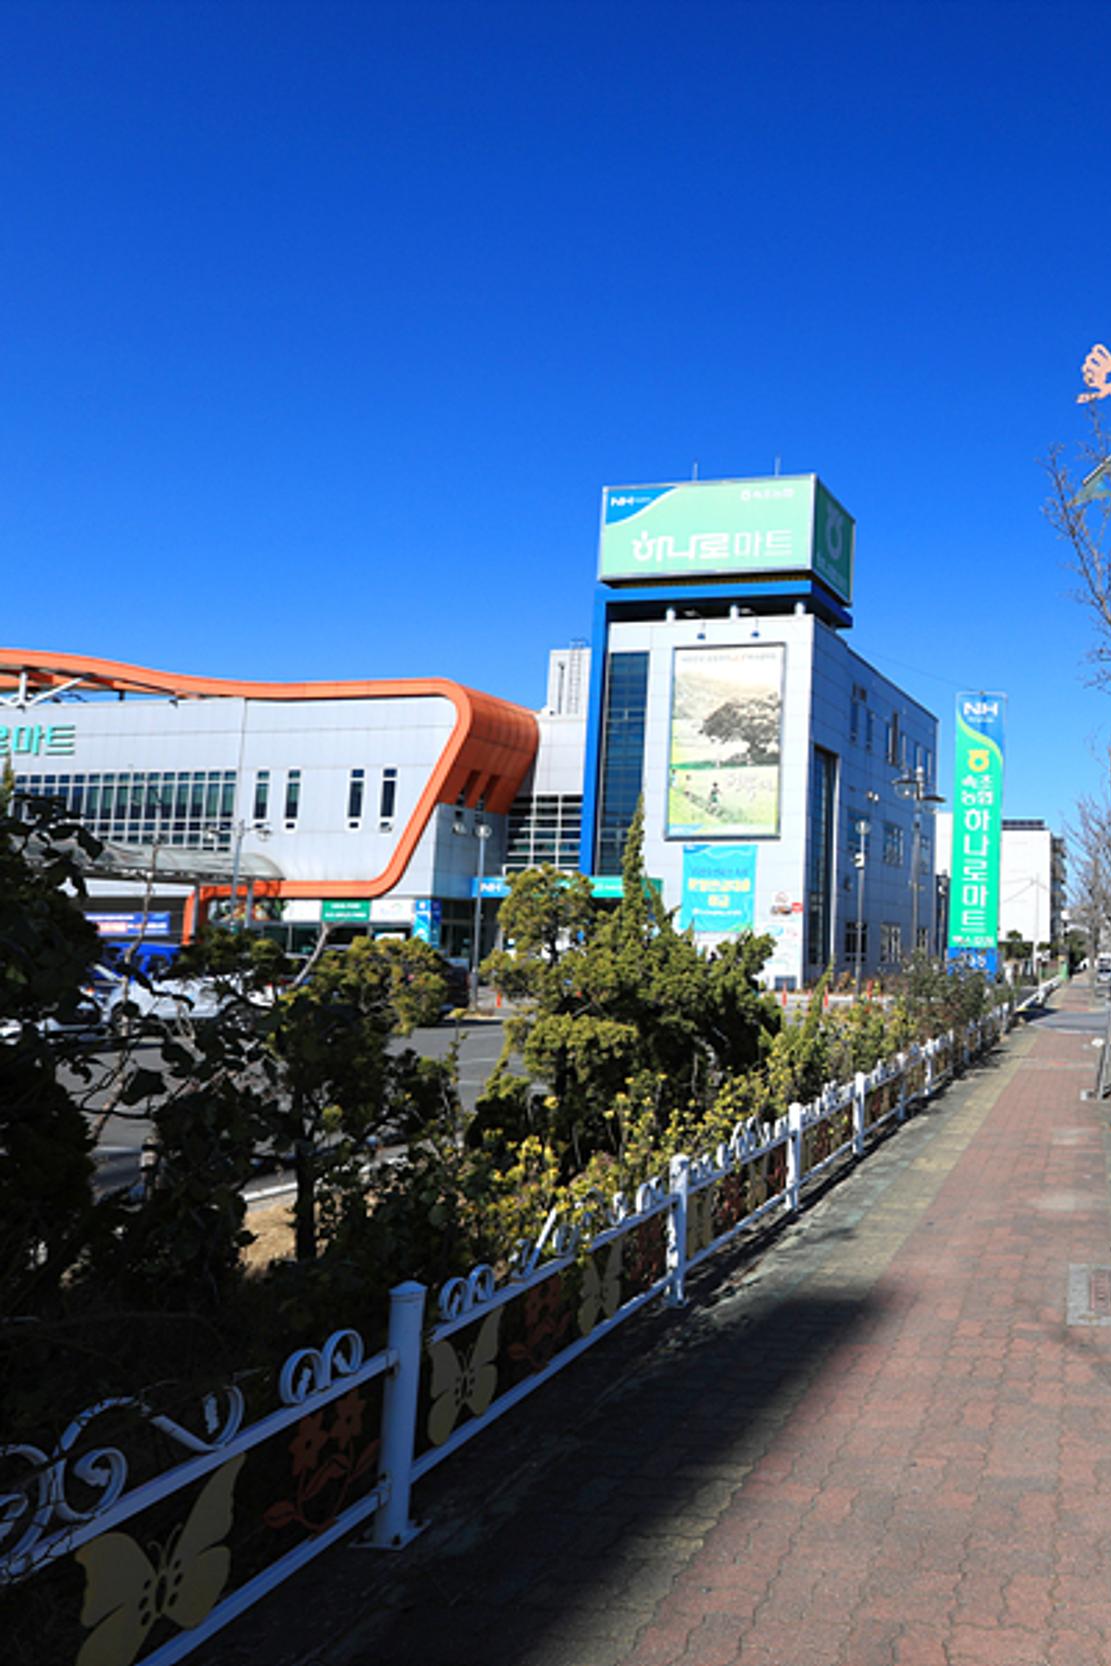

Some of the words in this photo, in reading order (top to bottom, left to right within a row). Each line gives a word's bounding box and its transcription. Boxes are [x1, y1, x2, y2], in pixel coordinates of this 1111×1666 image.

[610, 495, 634, 507] NH
[631, 529, 793, 562] 하나로마트
[963, 702, 999, 717] NH
[960, 808, 991, 933] 하나로마트
